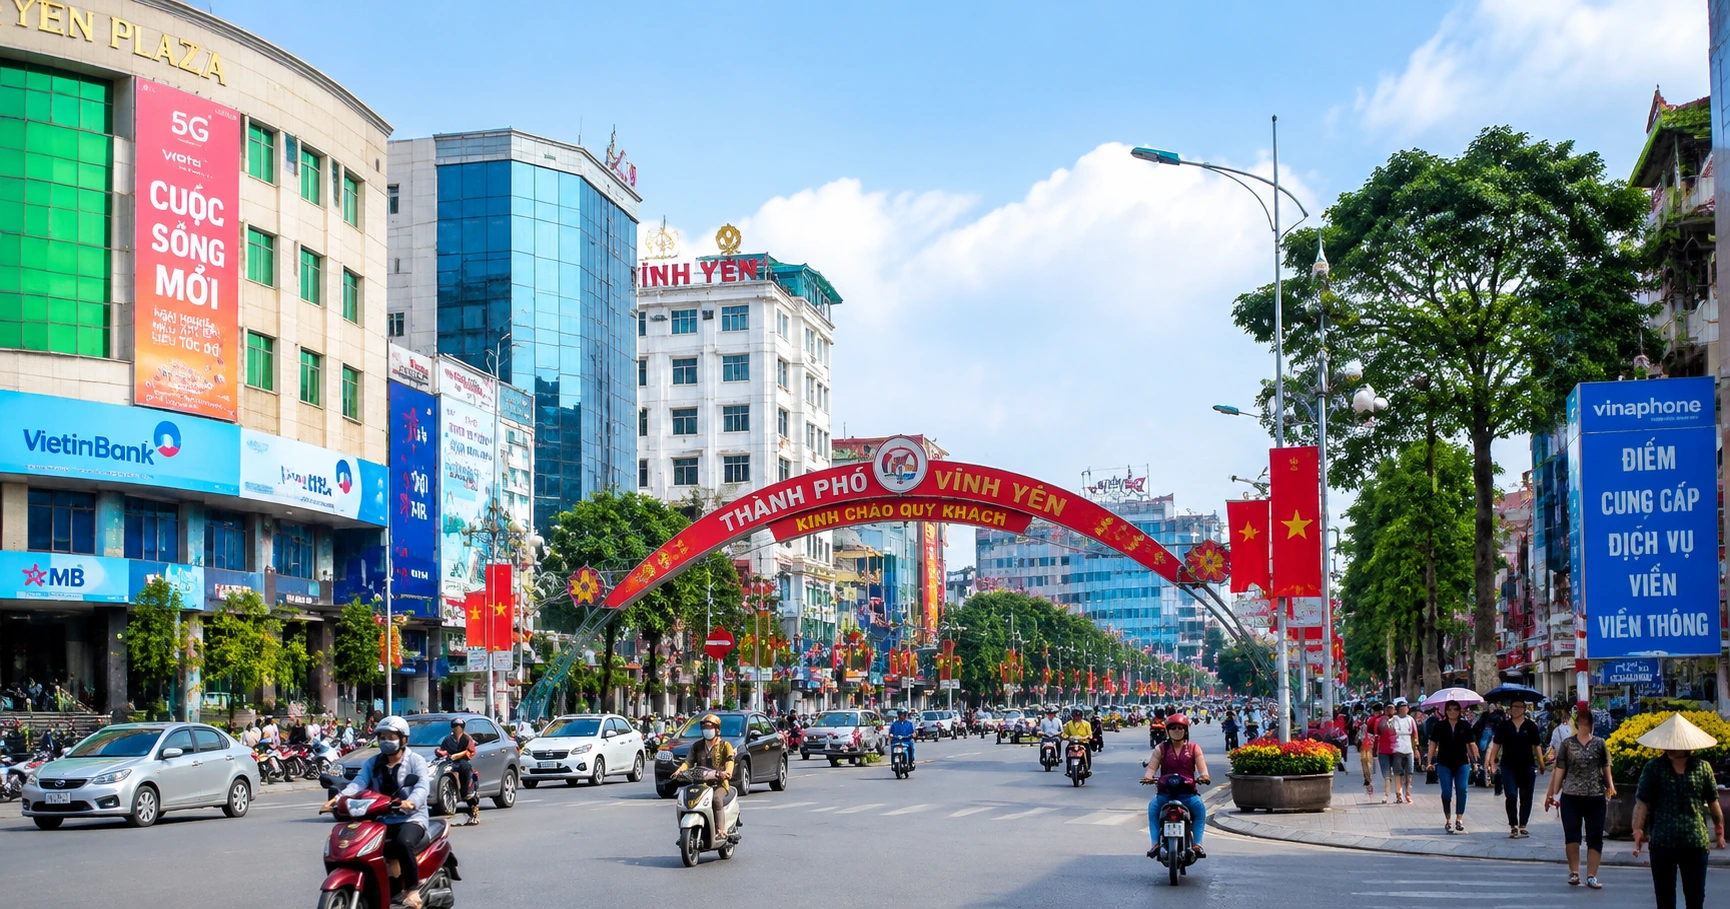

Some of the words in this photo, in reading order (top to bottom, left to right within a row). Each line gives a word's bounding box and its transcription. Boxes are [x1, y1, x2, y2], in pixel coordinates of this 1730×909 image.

[109, 16, 227, 87] PLAZA
[171, 110, 209, 143] 5G
[1592, 397, 1702, 419] vinaphone
[22, 428, 155, 465] VietinBank
[719, 485, 806, 533] THÀNH
[899, 503, 936, 518] QUY
[1601, 488, 1654, 516] CUNG
[1666, 529, 1694, 559] VỤ
[49, 567, 85, 588] MB
